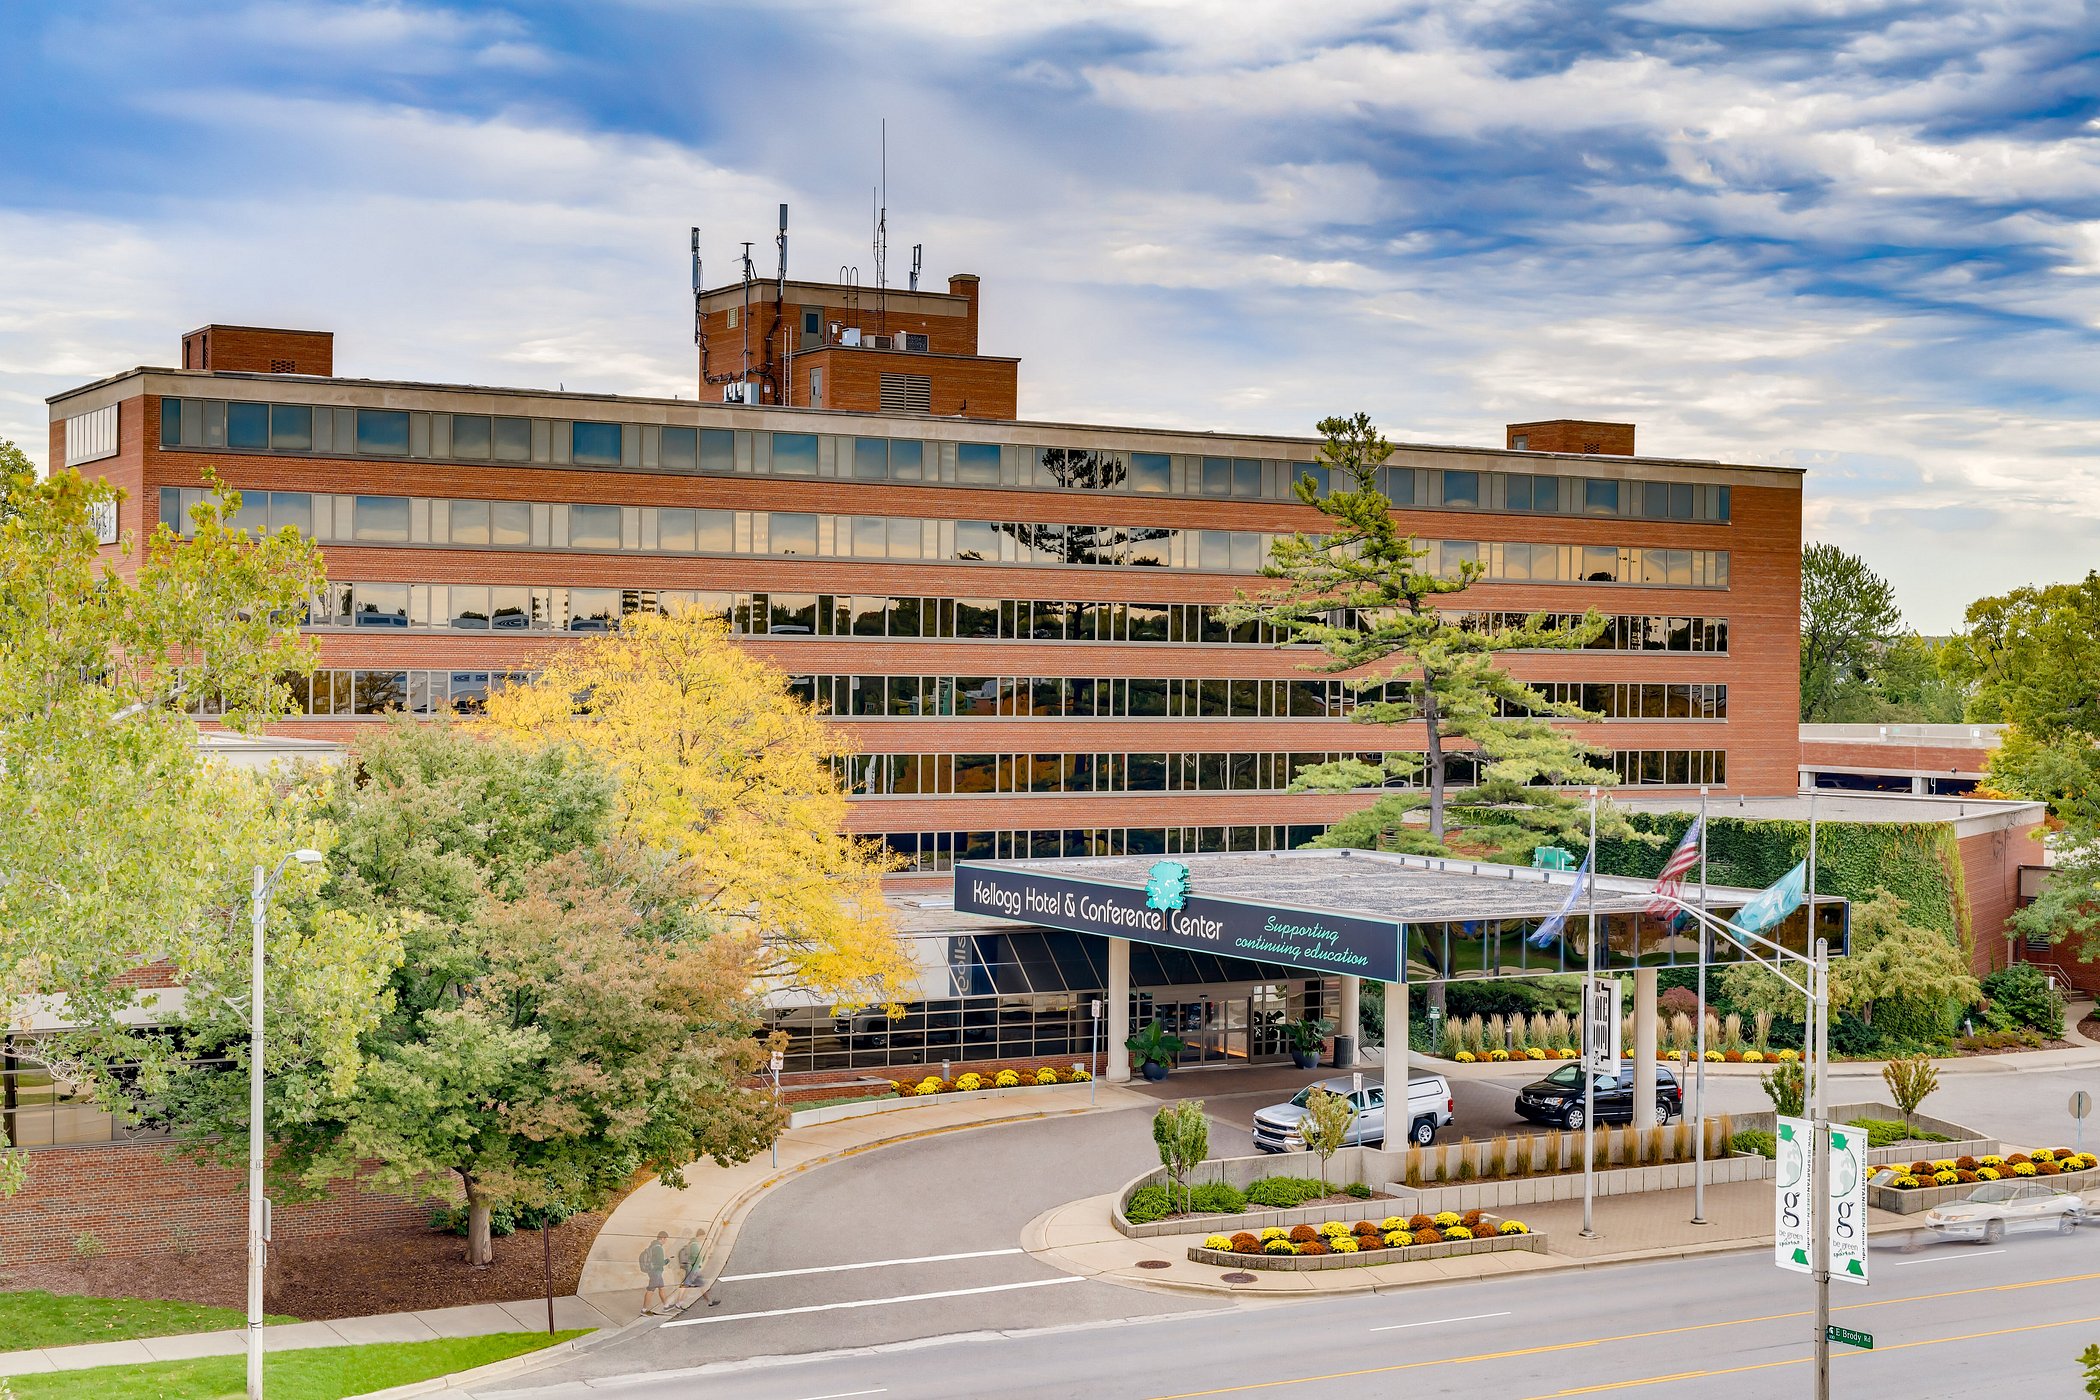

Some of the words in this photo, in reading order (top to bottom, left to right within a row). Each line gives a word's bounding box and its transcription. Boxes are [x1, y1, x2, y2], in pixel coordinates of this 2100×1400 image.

[973, 879, 1021, 915] Kellogg
[1025, 886, 1061, 915] Hotel
[1064, 892, 1076, 918] &
[1080, 895, 1161, 931] Conference
[1171, 910, 1223, 940] Center
[1264, 915, 1340, 946] Supporting
[1235, 934, 1301, 961] continuing
[1304, 941, 1369, 966] education
[1835, 1328, 1841, 1337] E
[1842, 1329, 1862, 1344] Brody
[1863, 1335, 1871, 1343] Rd
